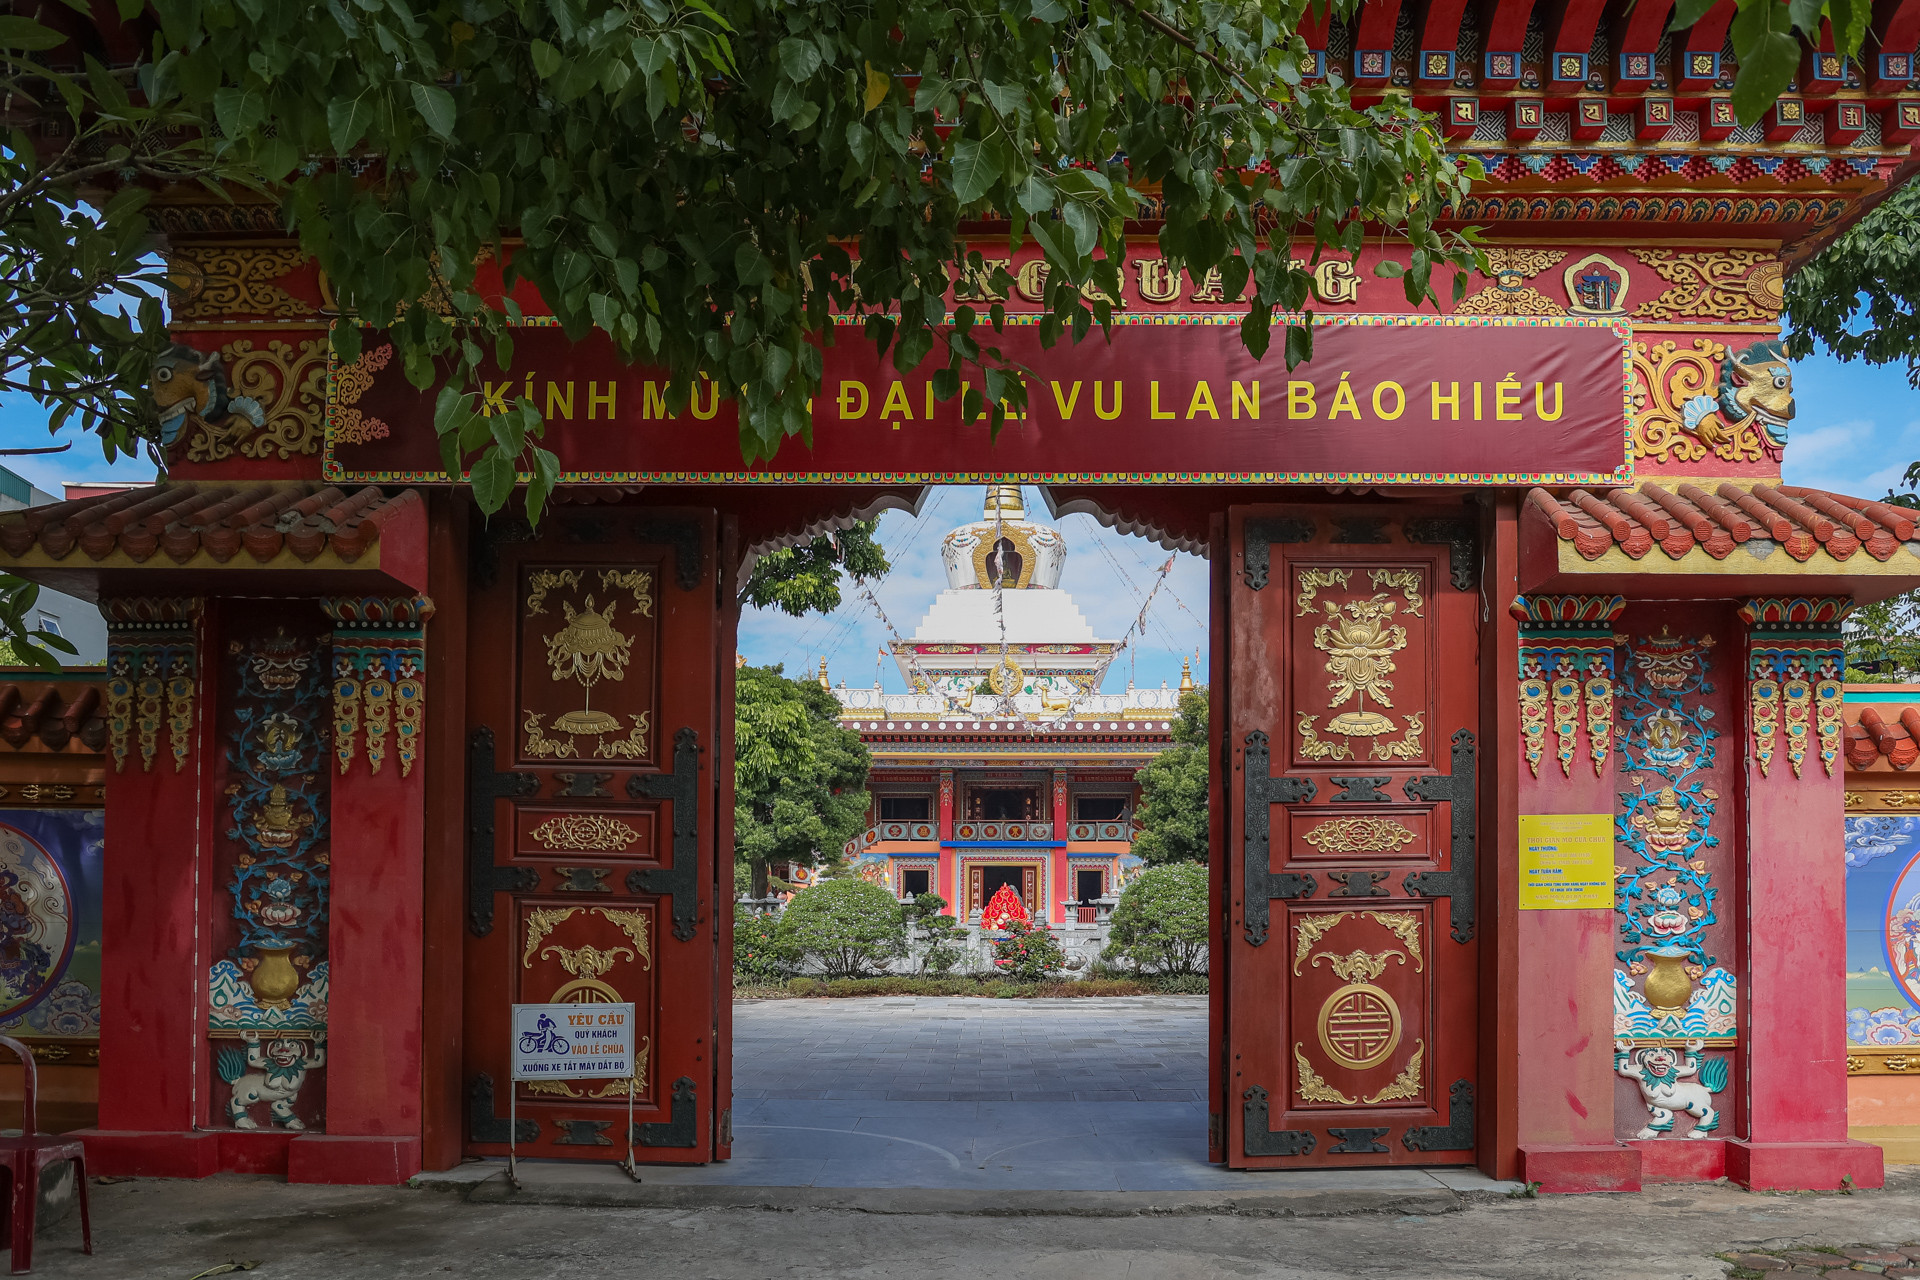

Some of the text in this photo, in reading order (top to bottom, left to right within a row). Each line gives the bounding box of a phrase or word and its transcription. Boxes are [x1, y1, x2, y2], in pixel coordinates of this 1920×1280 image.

[836, 380, 935, 430] ĐẠI
[1050, 380, 1123, 421] VU
[1150, 380, 1261, 420] LAN
[1287, 370, 1407, 421] BÁO
[1431, 372, 1564, 422] HIẾU
[567, 1012, 594, 1026] YÊU
[574, 1028, 618, 1039] QUÝ KHÁCH
[571, 1043, 588, 1055] VÀO
[522, 1060, 549, 1072] XUỐNG
[551, 1063, 561, 1071] XE
[579, 1060, 596, 1071] MÁY
[614, 1059, 625, 1071] BỘ
